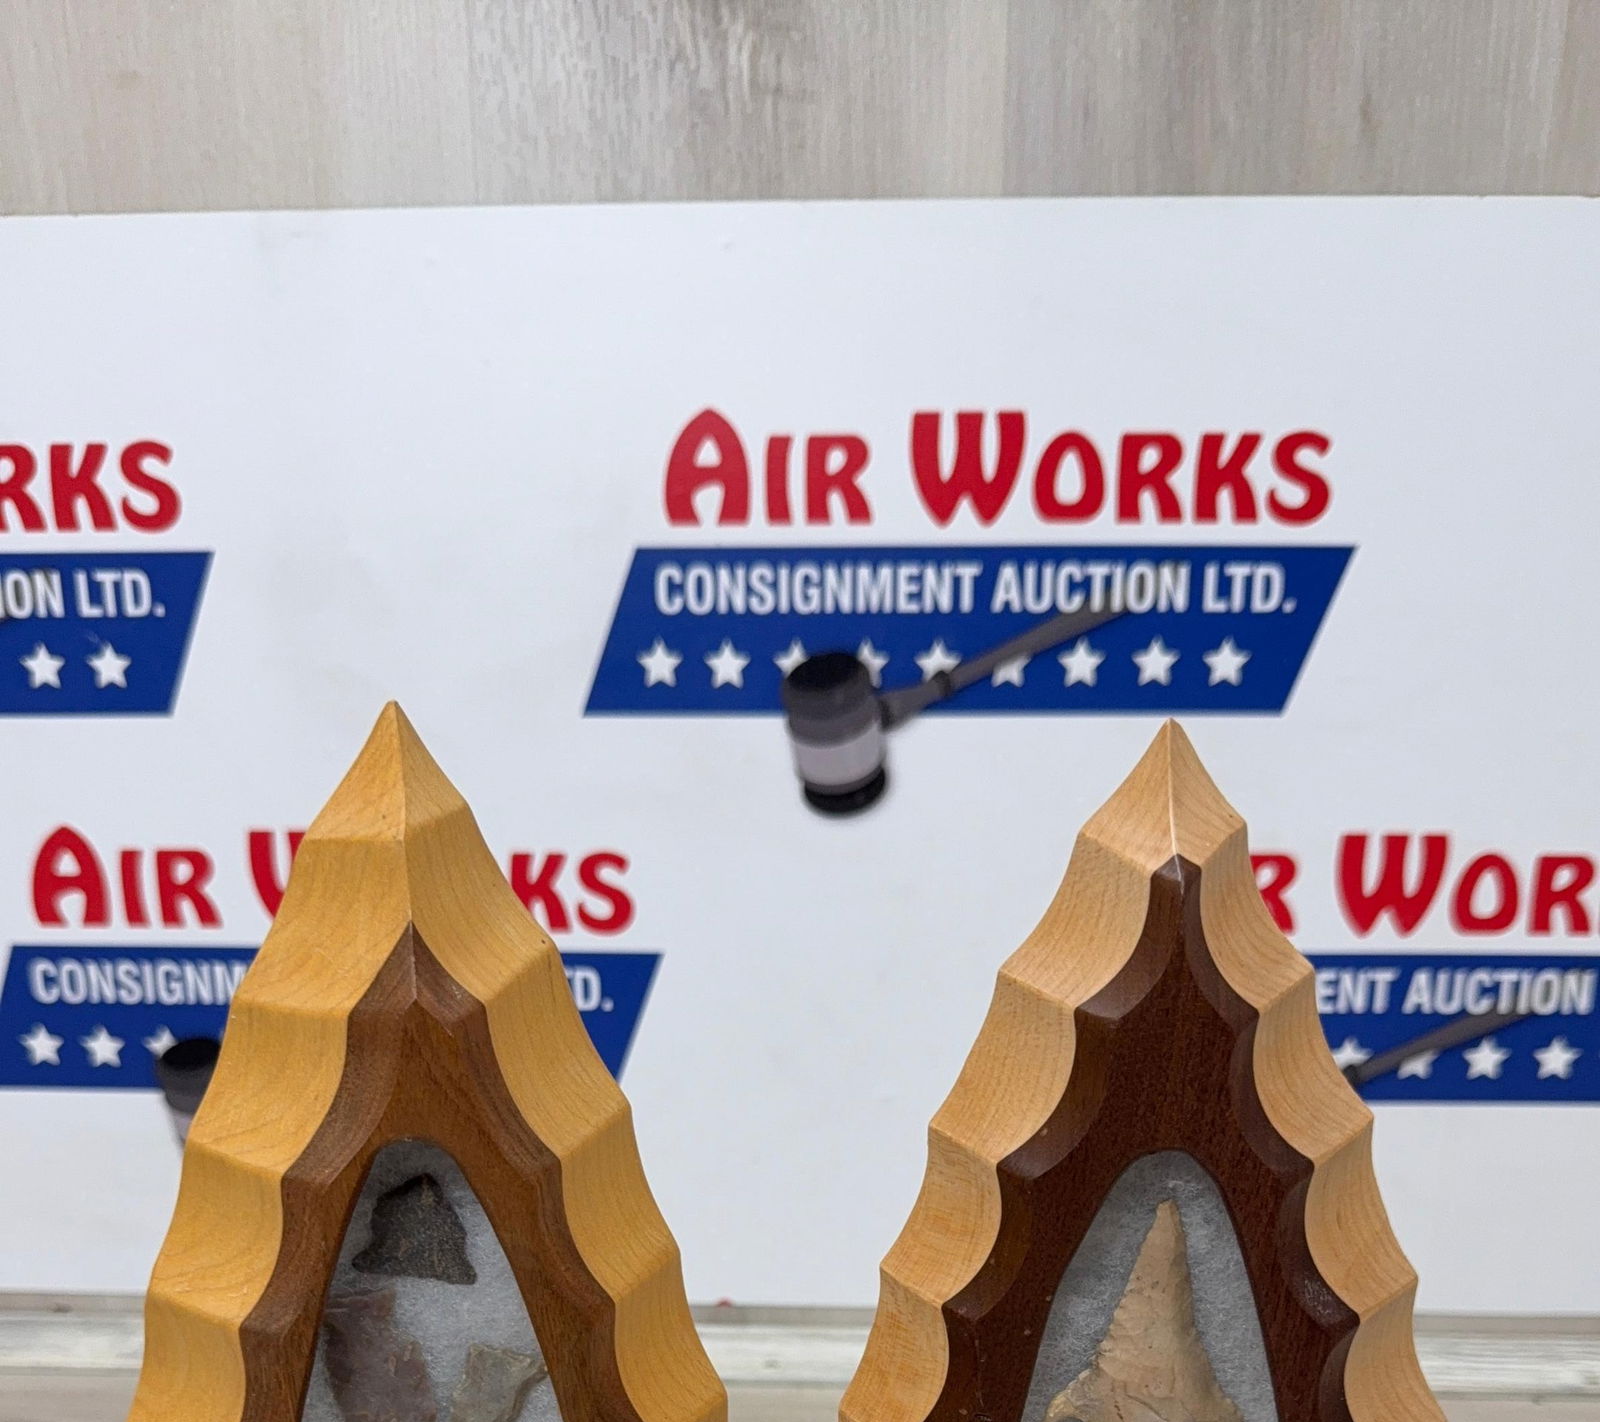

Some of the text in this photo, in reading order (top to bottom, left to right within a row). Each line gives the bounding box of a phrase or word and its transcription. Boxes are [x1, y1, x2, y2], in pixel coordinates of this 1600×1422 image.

[663, 408, 1332, 527] AIR WORKS
[0, 568, 167, 620] ON LTD.
[654, 562, 1296, 616] CONSIGNMENT AUCTION LTD.
[30, 824, 222, 929] AIR
[1335, 832, 1600, 938] WOR
[1400, 966, 1598, 1017] AUCTION
